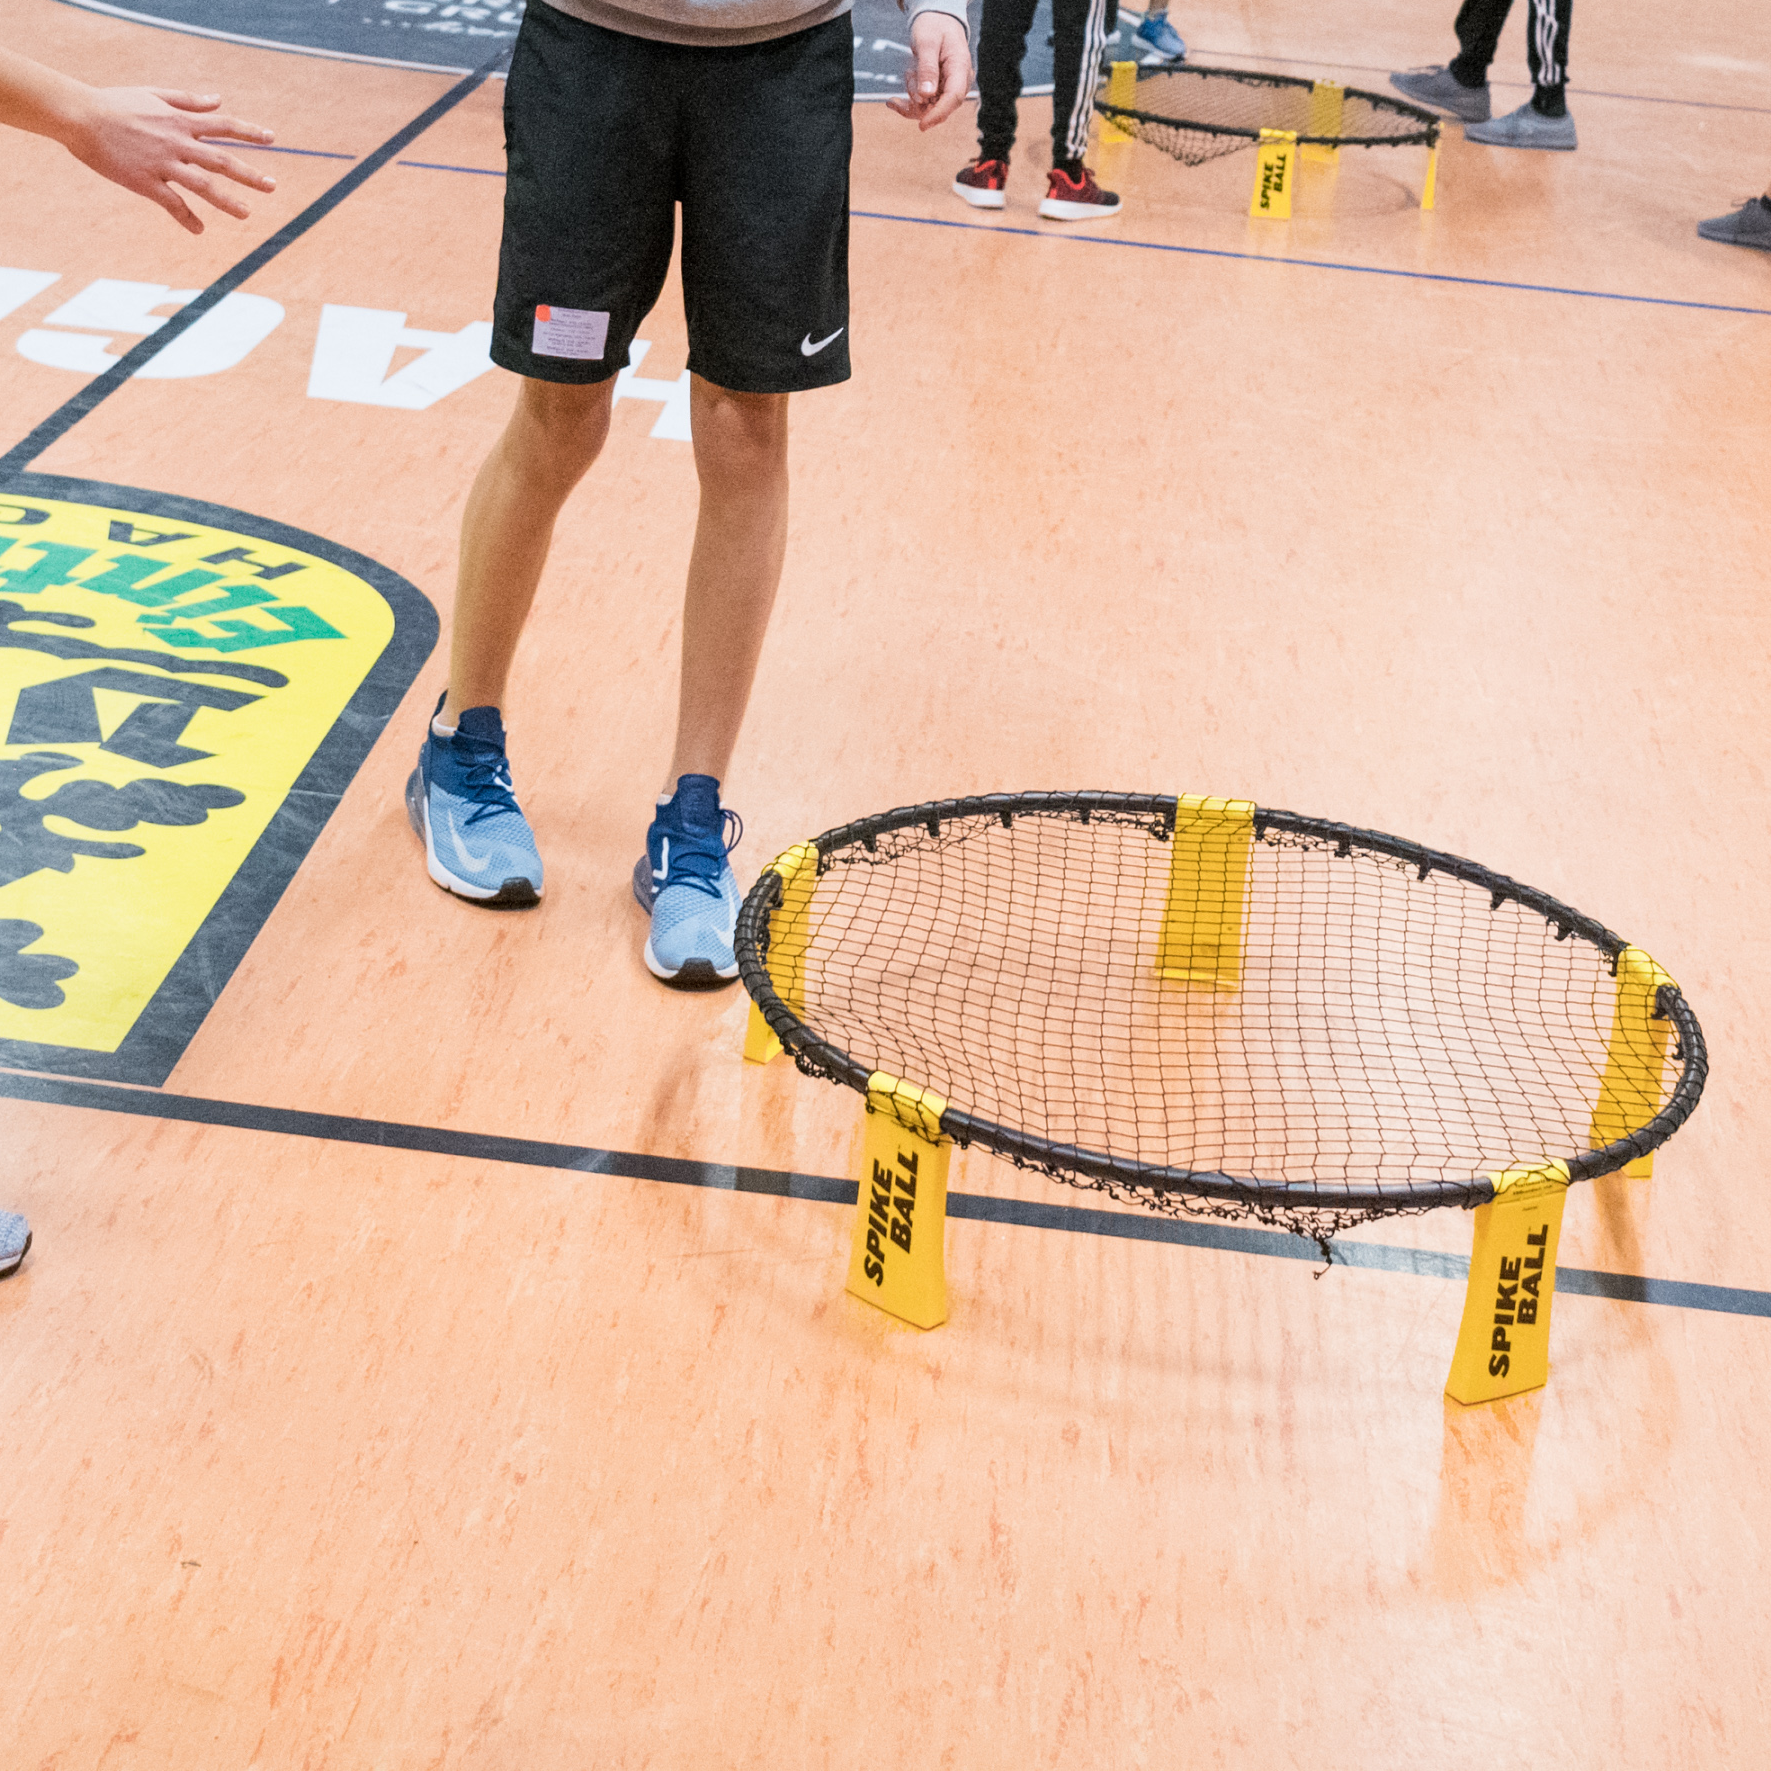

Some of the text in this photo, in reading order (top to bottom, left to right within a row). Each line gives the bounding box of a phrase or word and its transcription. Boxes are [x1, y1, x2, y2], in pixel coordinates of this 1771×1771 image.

[1260, 161, 1274, 210] SPIKE
[1273, 154, 1287, 193] BALL
[864, 1157, 893, 1288] SPIKE
[889, 1149, 919, 1255] BALL
[1488, 1255, 1522, 1379] SPIKE
[1516, 1223, 1549, 1325] BALL
